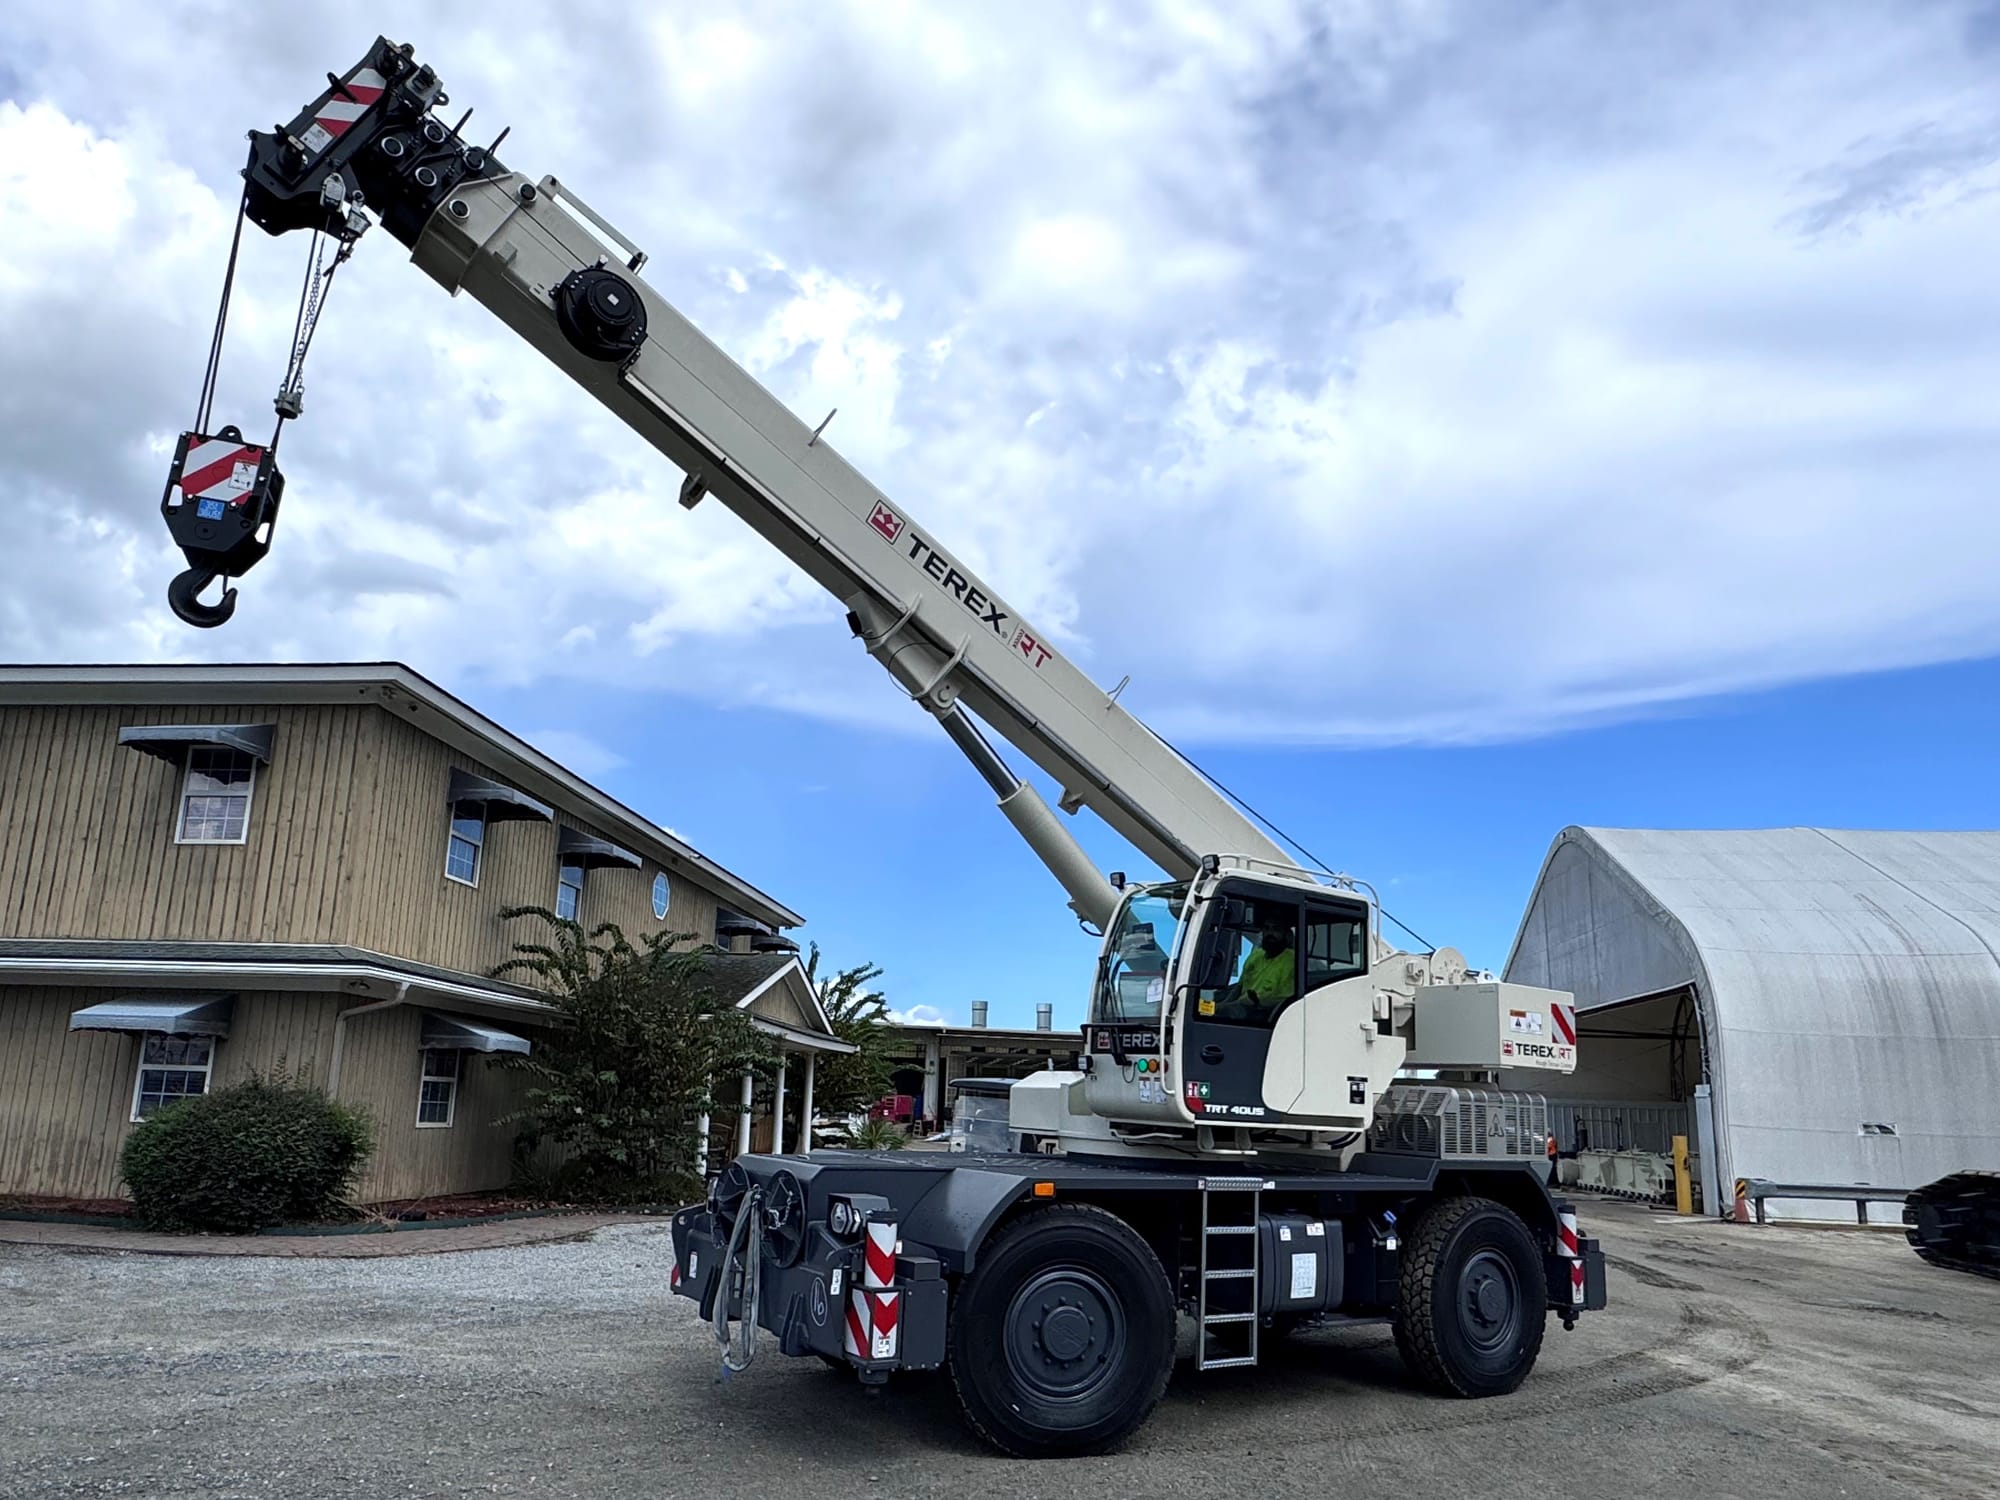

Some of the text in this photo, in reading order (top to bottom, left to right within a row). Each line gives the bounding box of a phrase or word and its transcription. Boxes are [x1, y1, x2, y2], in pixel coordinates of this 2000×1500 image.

[908, 532, 1053, 669] TEREX RT
[1114, 1033, 1161, 1048] EREX
[1515, 1042, 1572, 1060] TEREX RT
[1204, 1104, 1230, 1114] TRT
